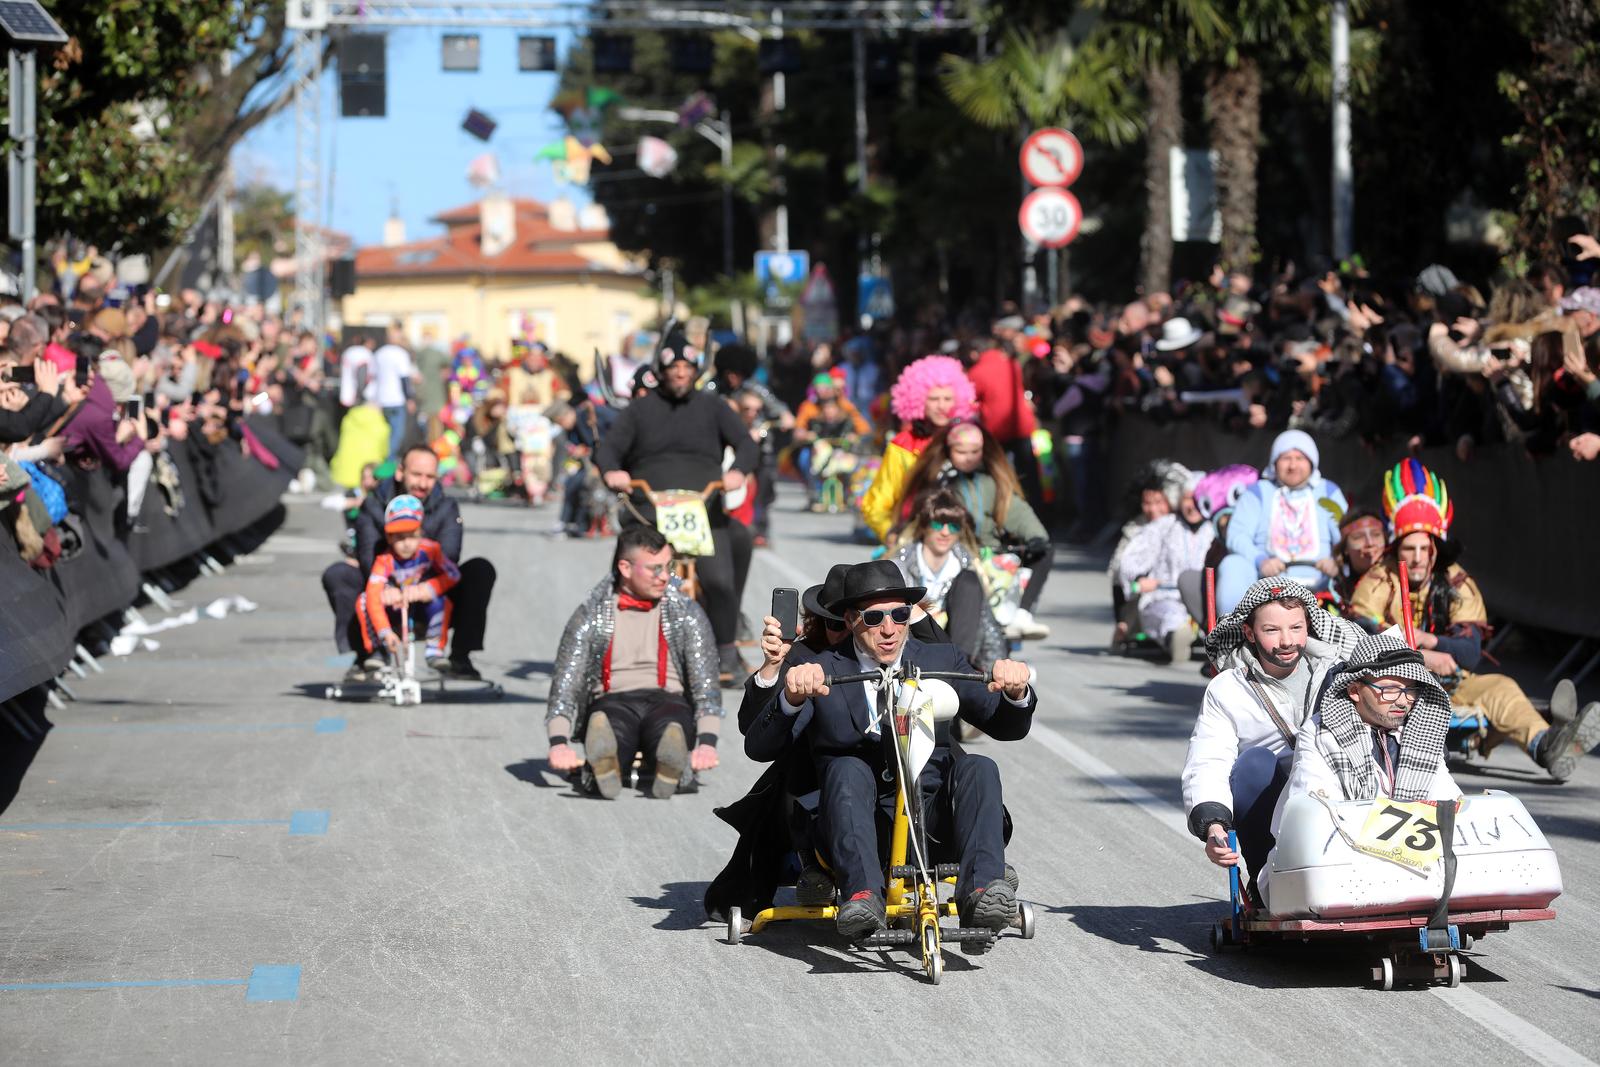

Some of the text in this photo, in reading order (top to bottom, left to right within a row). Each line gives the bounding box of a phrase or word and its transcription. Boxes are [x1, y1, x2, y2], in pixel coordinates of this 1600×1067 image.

[1037, 206, 1068, 229] 30
[664, 511, 697, 532] 38
[1376, 804, 1440, 851] 73
